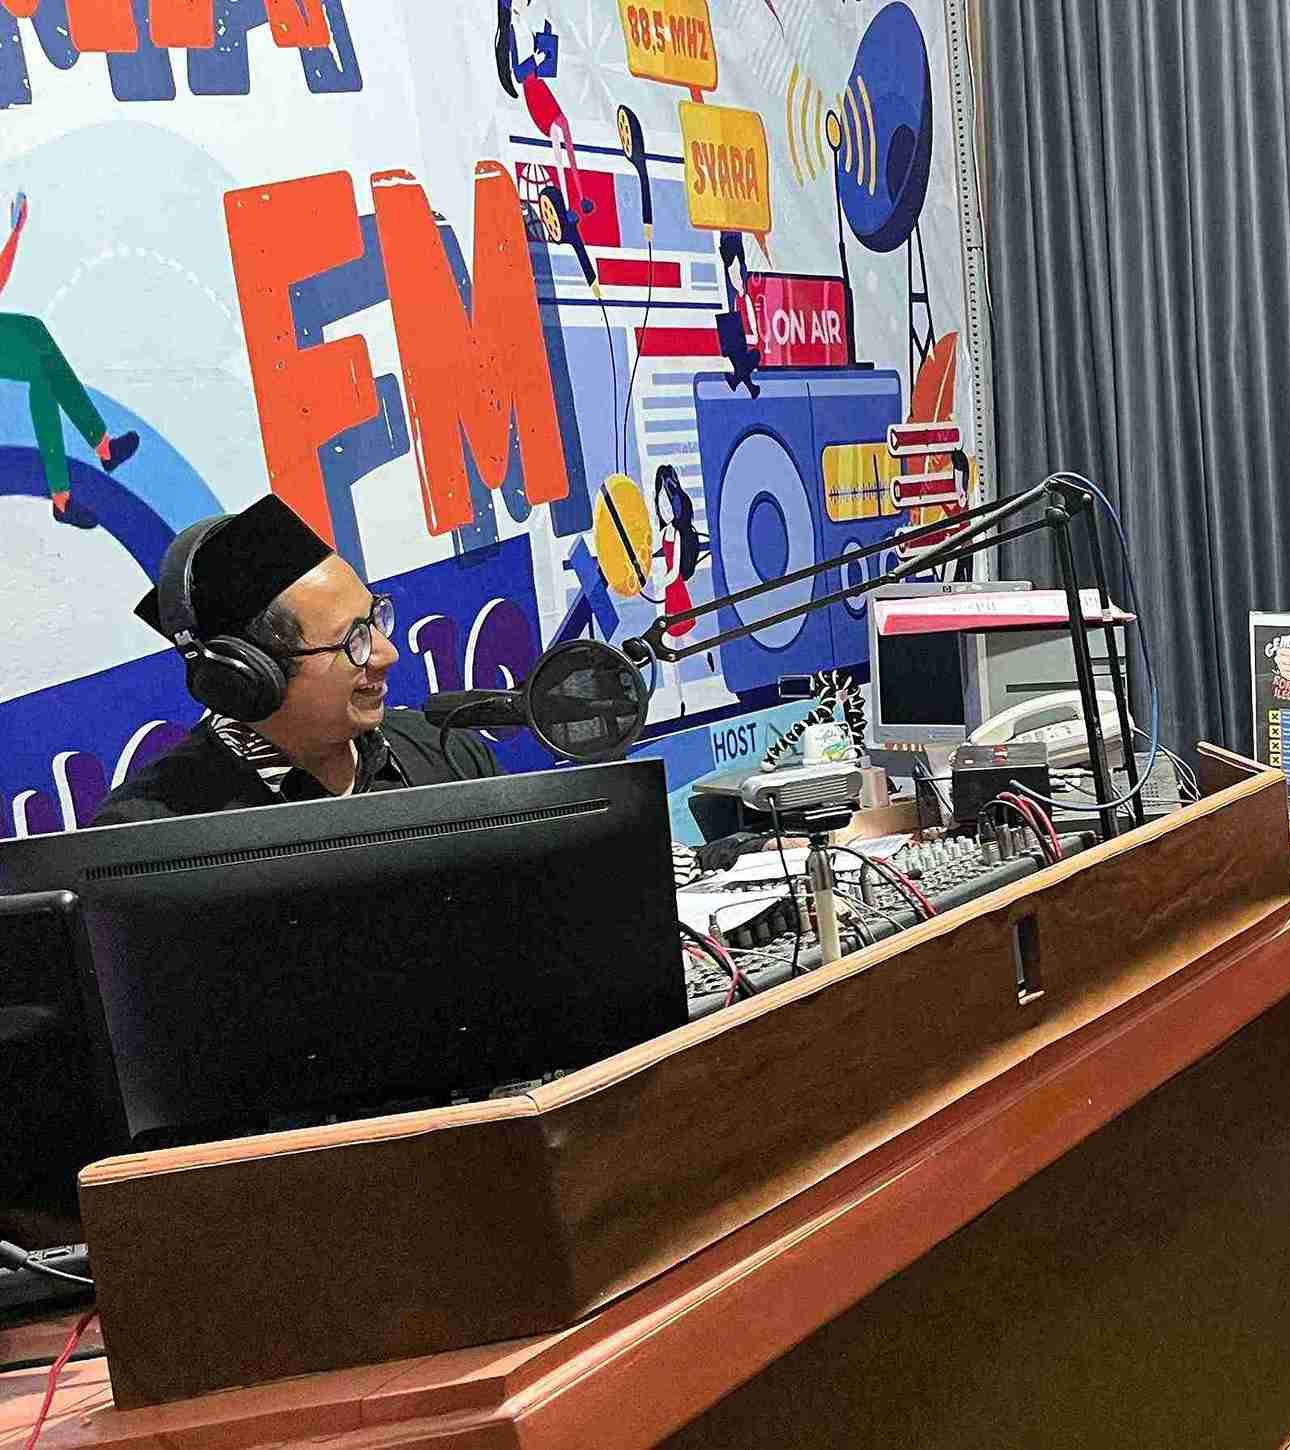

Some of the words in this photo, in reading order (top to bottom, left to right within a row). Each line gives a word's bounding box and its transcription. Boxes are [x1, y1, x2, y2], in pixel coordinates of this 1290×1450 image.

[772, 308, 806, 345] ON
[811, 309, 842, 345] AIR
[224, 160, 571, 552] FM
[713, 722, 757, 764] HOST
